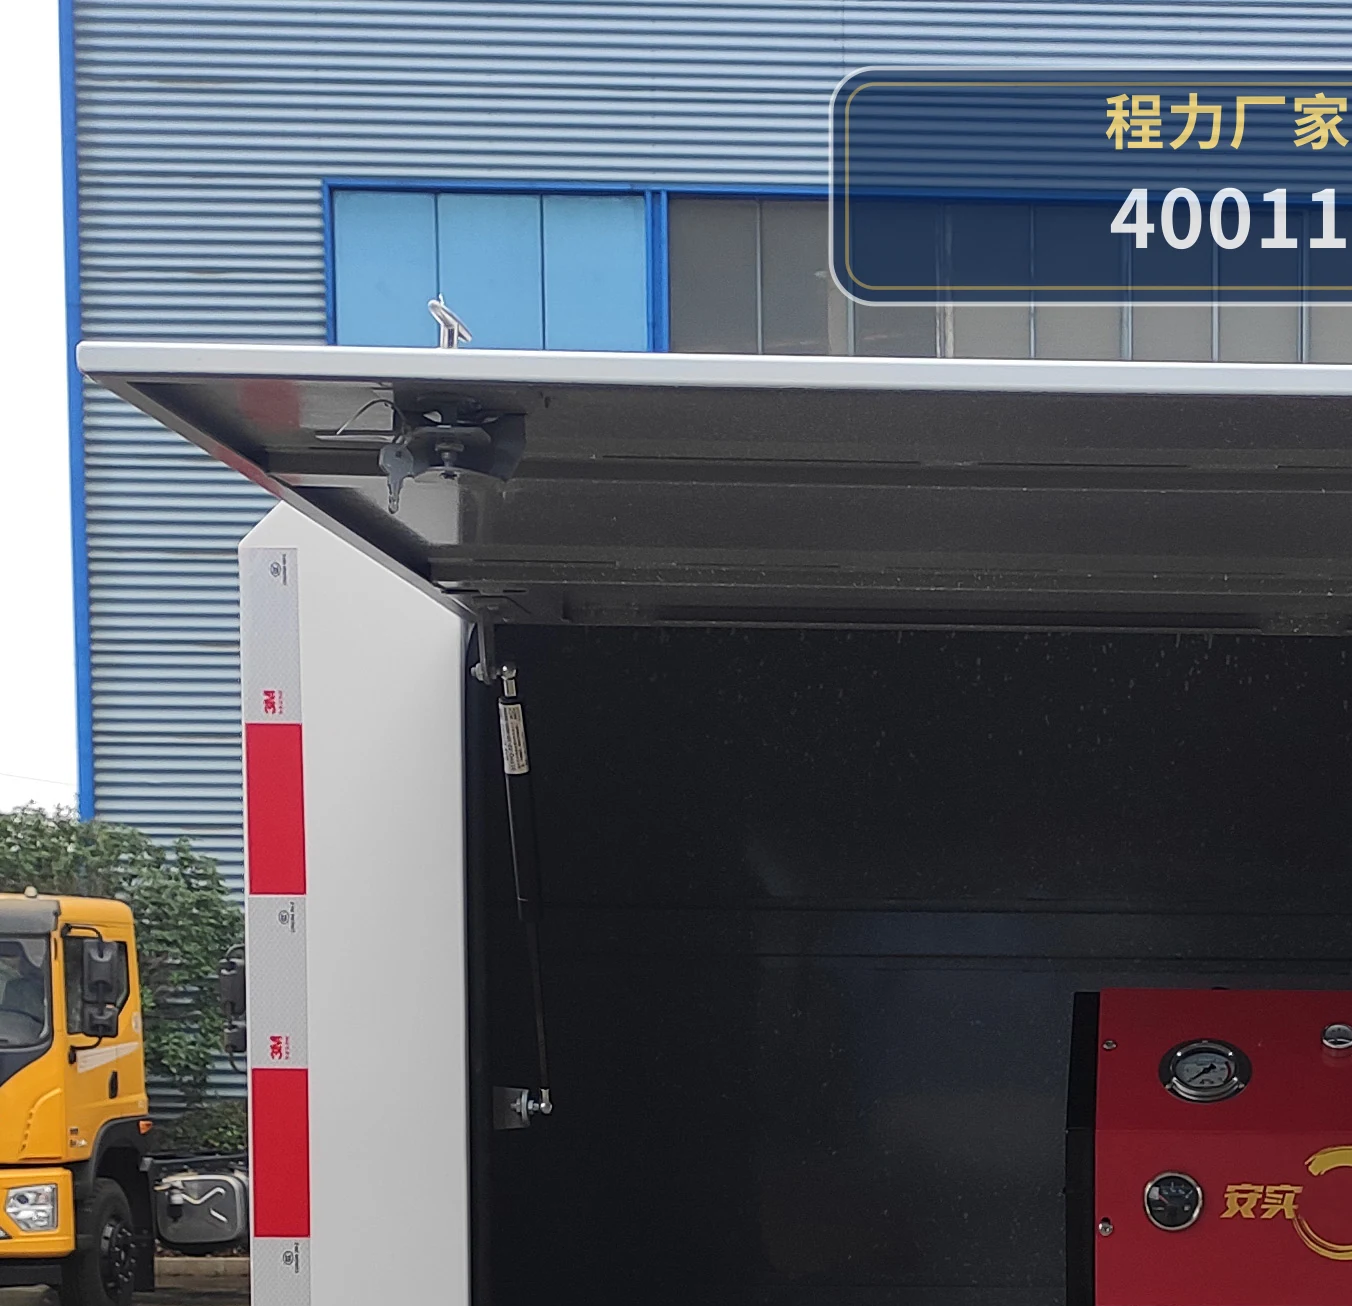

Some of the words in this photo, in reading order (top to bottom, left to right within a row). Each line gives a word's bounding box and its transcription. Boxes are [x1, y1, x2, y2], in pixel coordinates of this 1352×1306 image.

[264, 690, 276, 715] 3M
[270, 1035, 283, 1060] 3M
[1220, 1183, 1303, 1219] 安实
